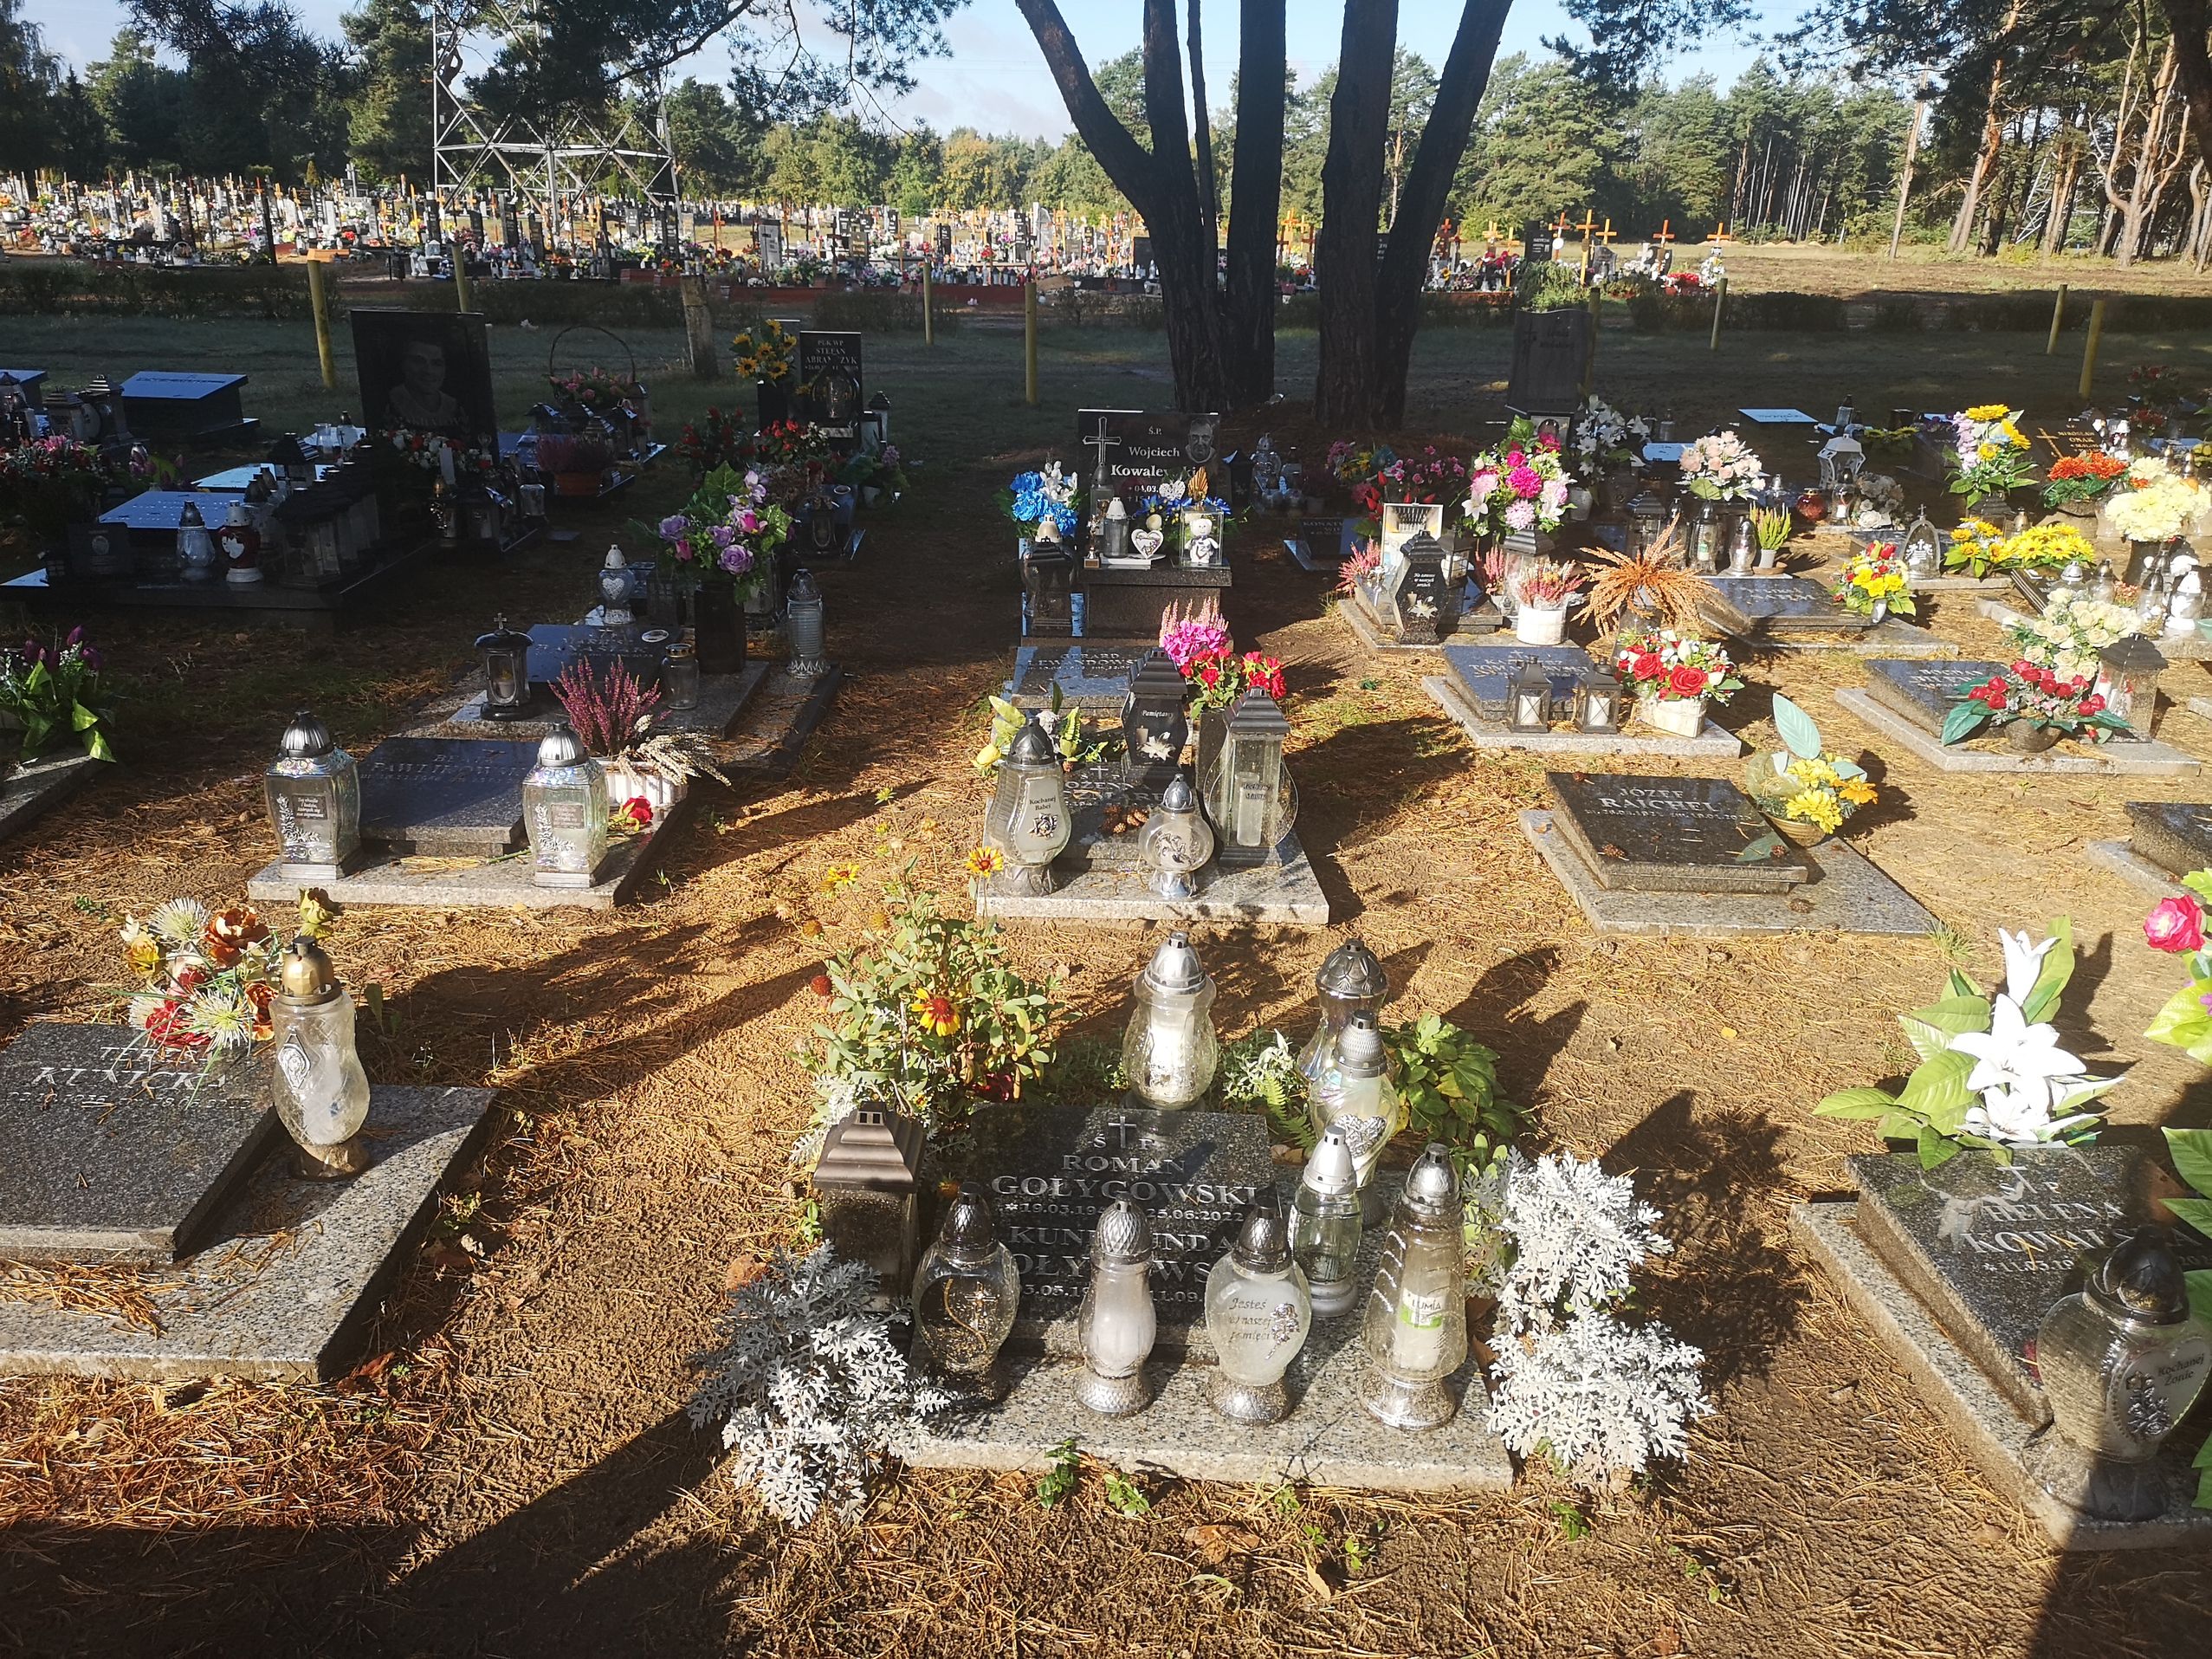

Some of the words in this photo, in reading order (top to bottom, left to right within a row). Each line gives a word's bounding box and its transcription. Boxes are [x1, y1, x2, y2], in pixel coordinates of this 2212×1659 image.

[1129, 446, 1180, 459] Wojciech
[1029, 796, 1057, 807] Kochanej
[1598, 797, 1722, 813] RAICHEL
[100, 1045, 210, 1065] TERES
[1061, 1154, 1187, 1175] ROMAN
[991, 1174, 1258, 1206] GOŁYGOWSKI
[1146, 1208, 1245, 1222] 25.06.2022
[1982, 1202, 2126, 1222] HELENA
[1228, 1297, 1268, 1310] Jesteś
